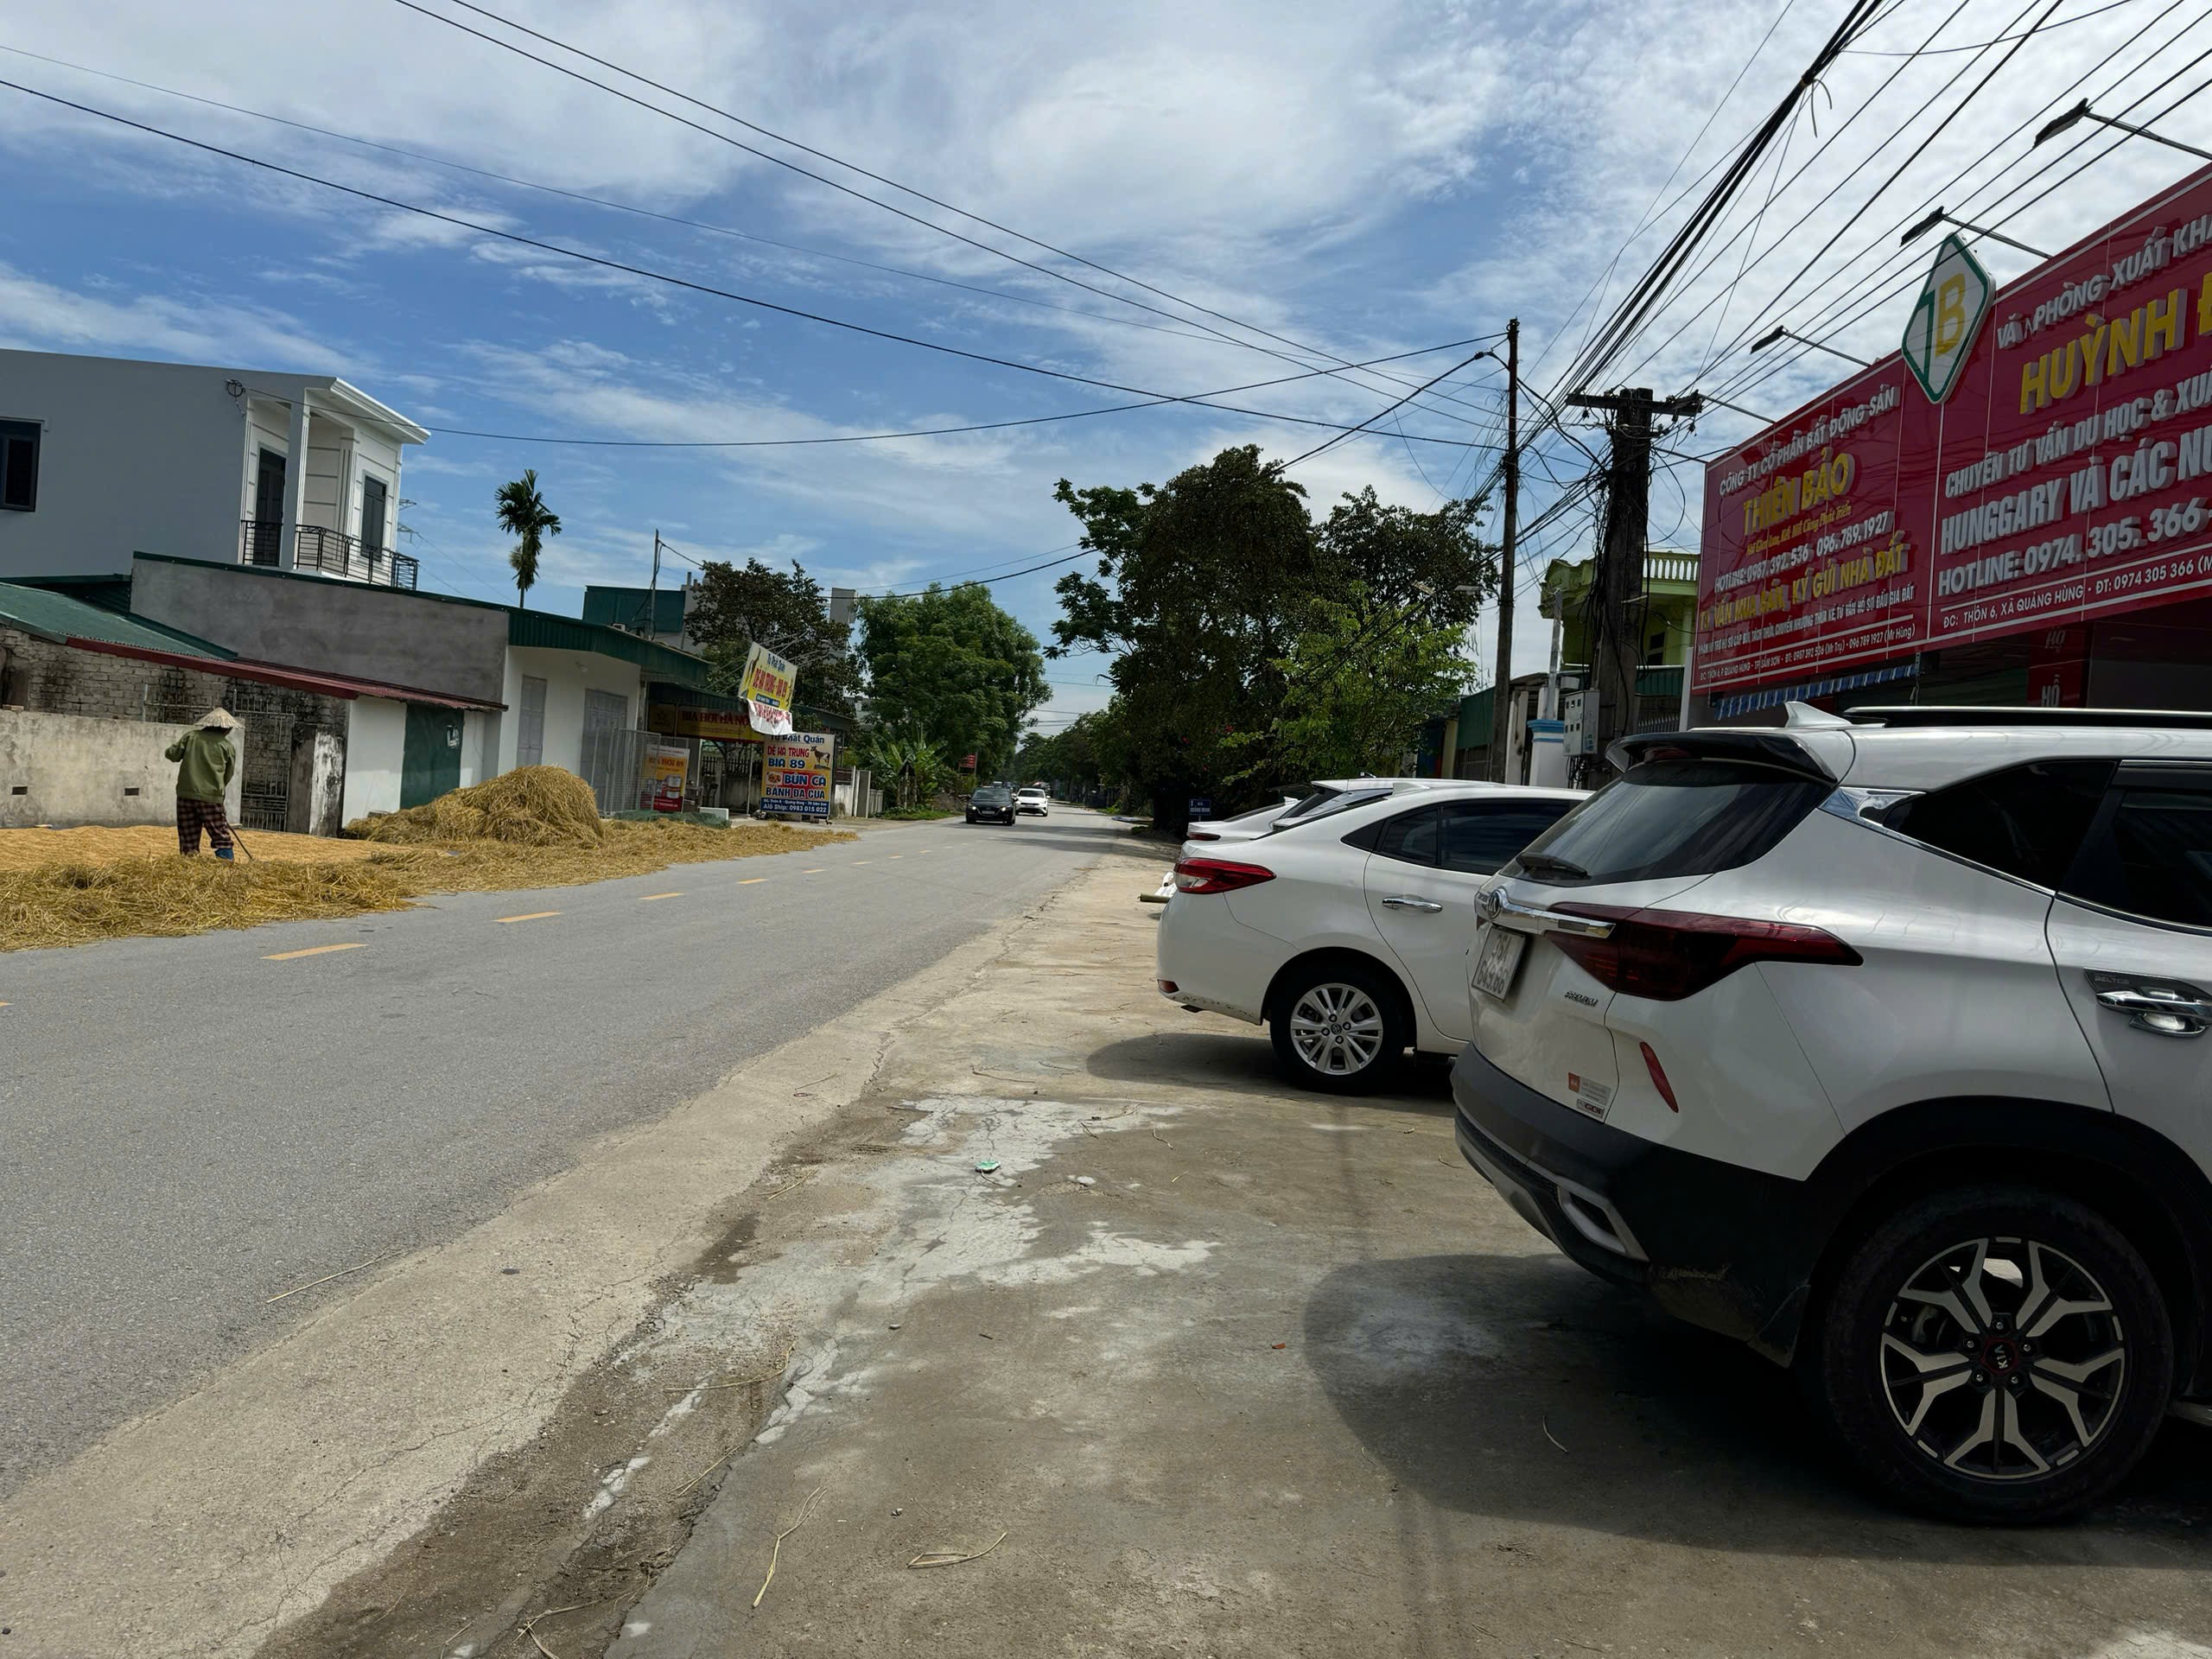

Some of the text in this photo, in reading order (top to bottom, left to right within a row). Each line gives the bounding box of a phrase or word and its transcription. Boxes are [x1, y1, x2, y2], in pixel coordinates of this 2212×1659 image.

[2034, 275, 2110, 331] PHÒNG
[2109, 226, 2173, 291] XUẤT
[2019, 289, 2187, 415] HUỲNH
[1719, 385, 1900, 496] CÔNG TY CỔ PHẦN BẤT ĐỘNG SẢN
[1946, 452, 2008, 499] CHUYÊN
[2007, 439, 2032, 475] TƯ
[2034, 421, 2074, 465] VẤN
[2074, 416, 2104, 451] DU
[2104, 397, 2152, 442] HỌC
[2152, 389, 2173, 421] &
[1744, 447, 1855, 536] THIÊN BẢO
[1864, 511, 1893, 539] 1927
[1941, 478, 2068, 554] HUNGGARY
[2069, 456, 2107, 514] VÀ
[2109, 437, 2176, 502] CÁC
[1792, 567, 1812, 606] KÝ
[1813, 558, 1840, 598] GỬI
[1840, 547, 1875, 589] NHÀ
[1875, 530, 1910, 580] ĐẤT
[1938, 497, 2206, 596] HOTLINE: 0974. 305. 366
[1943, 614, 1959, 628] ĐC:
[1964, 604, 1987, 621] THÔN
[1989, 607, 1999, 620] 6,
[2000, 599, 2015, 615] XÃ
[2017, 591, 2052, 612] QUẢNG
[2055, 583, 2083, 606] HÙNG
[2095, 578, 2112, 594] ĐT:
[2113, 570, 2142, 591] 0974
[2145, 564, 2167, 585] 305
[2170, 559, 2195, 578] 366
[1871, 631, 1884, 645] 1927
[768, 758, 805, 769] BIA 89
[788, 747, 809, 758] TRUNG
[804, 734, 824, 744] Quán
[766, 785, 791, 797] BÁNH
[808, 790, 825, 799] CUA
[785, 772, 826, 786] BÚN CÁ
[1993, 1344, 2009, 1370] KIA
